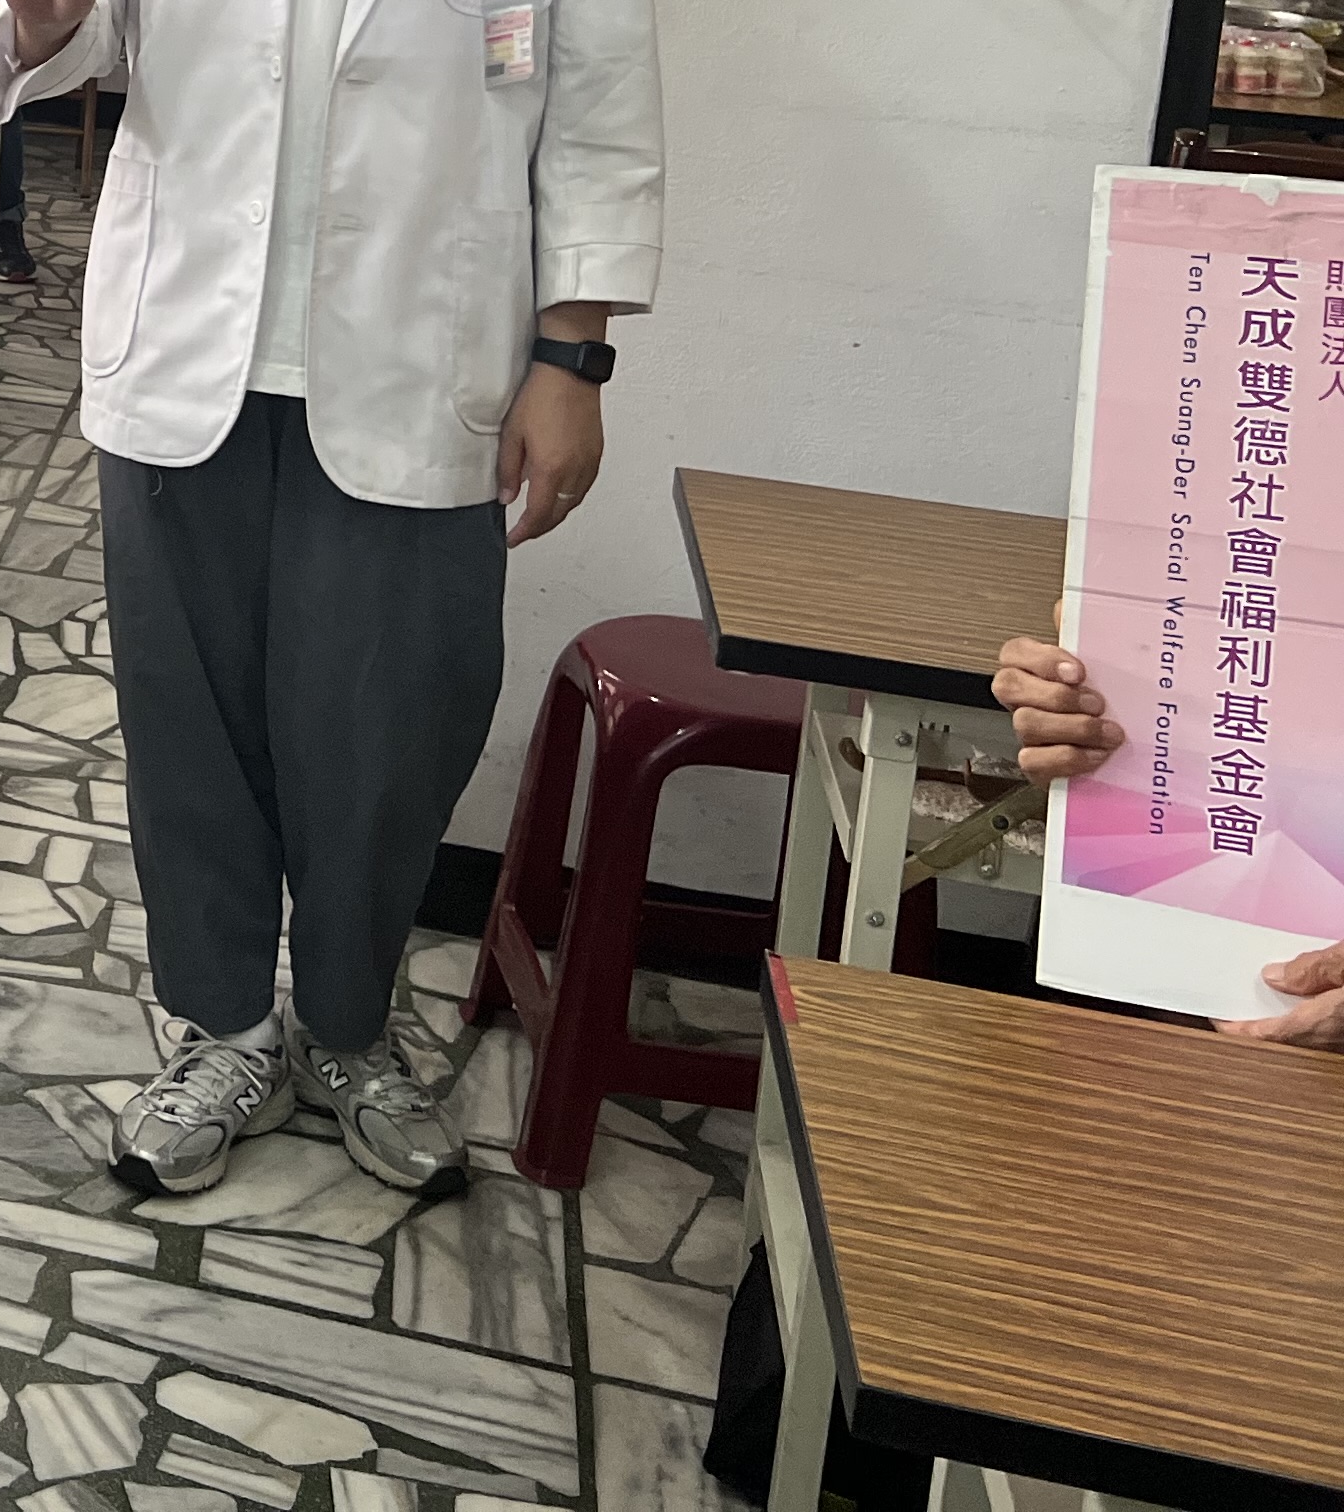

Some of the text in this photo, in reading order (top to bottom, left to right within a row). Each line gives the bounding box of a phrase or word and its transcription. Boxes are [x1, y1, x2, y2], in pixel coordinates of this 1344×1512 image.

[1150, 252, 1211, 835] Ten Chen Suang-Der Social Welfare Foundation
[1208, 254, 1300, 856] 天成雙德社會福利基金會
[320, 1059, 350, 1090] N
